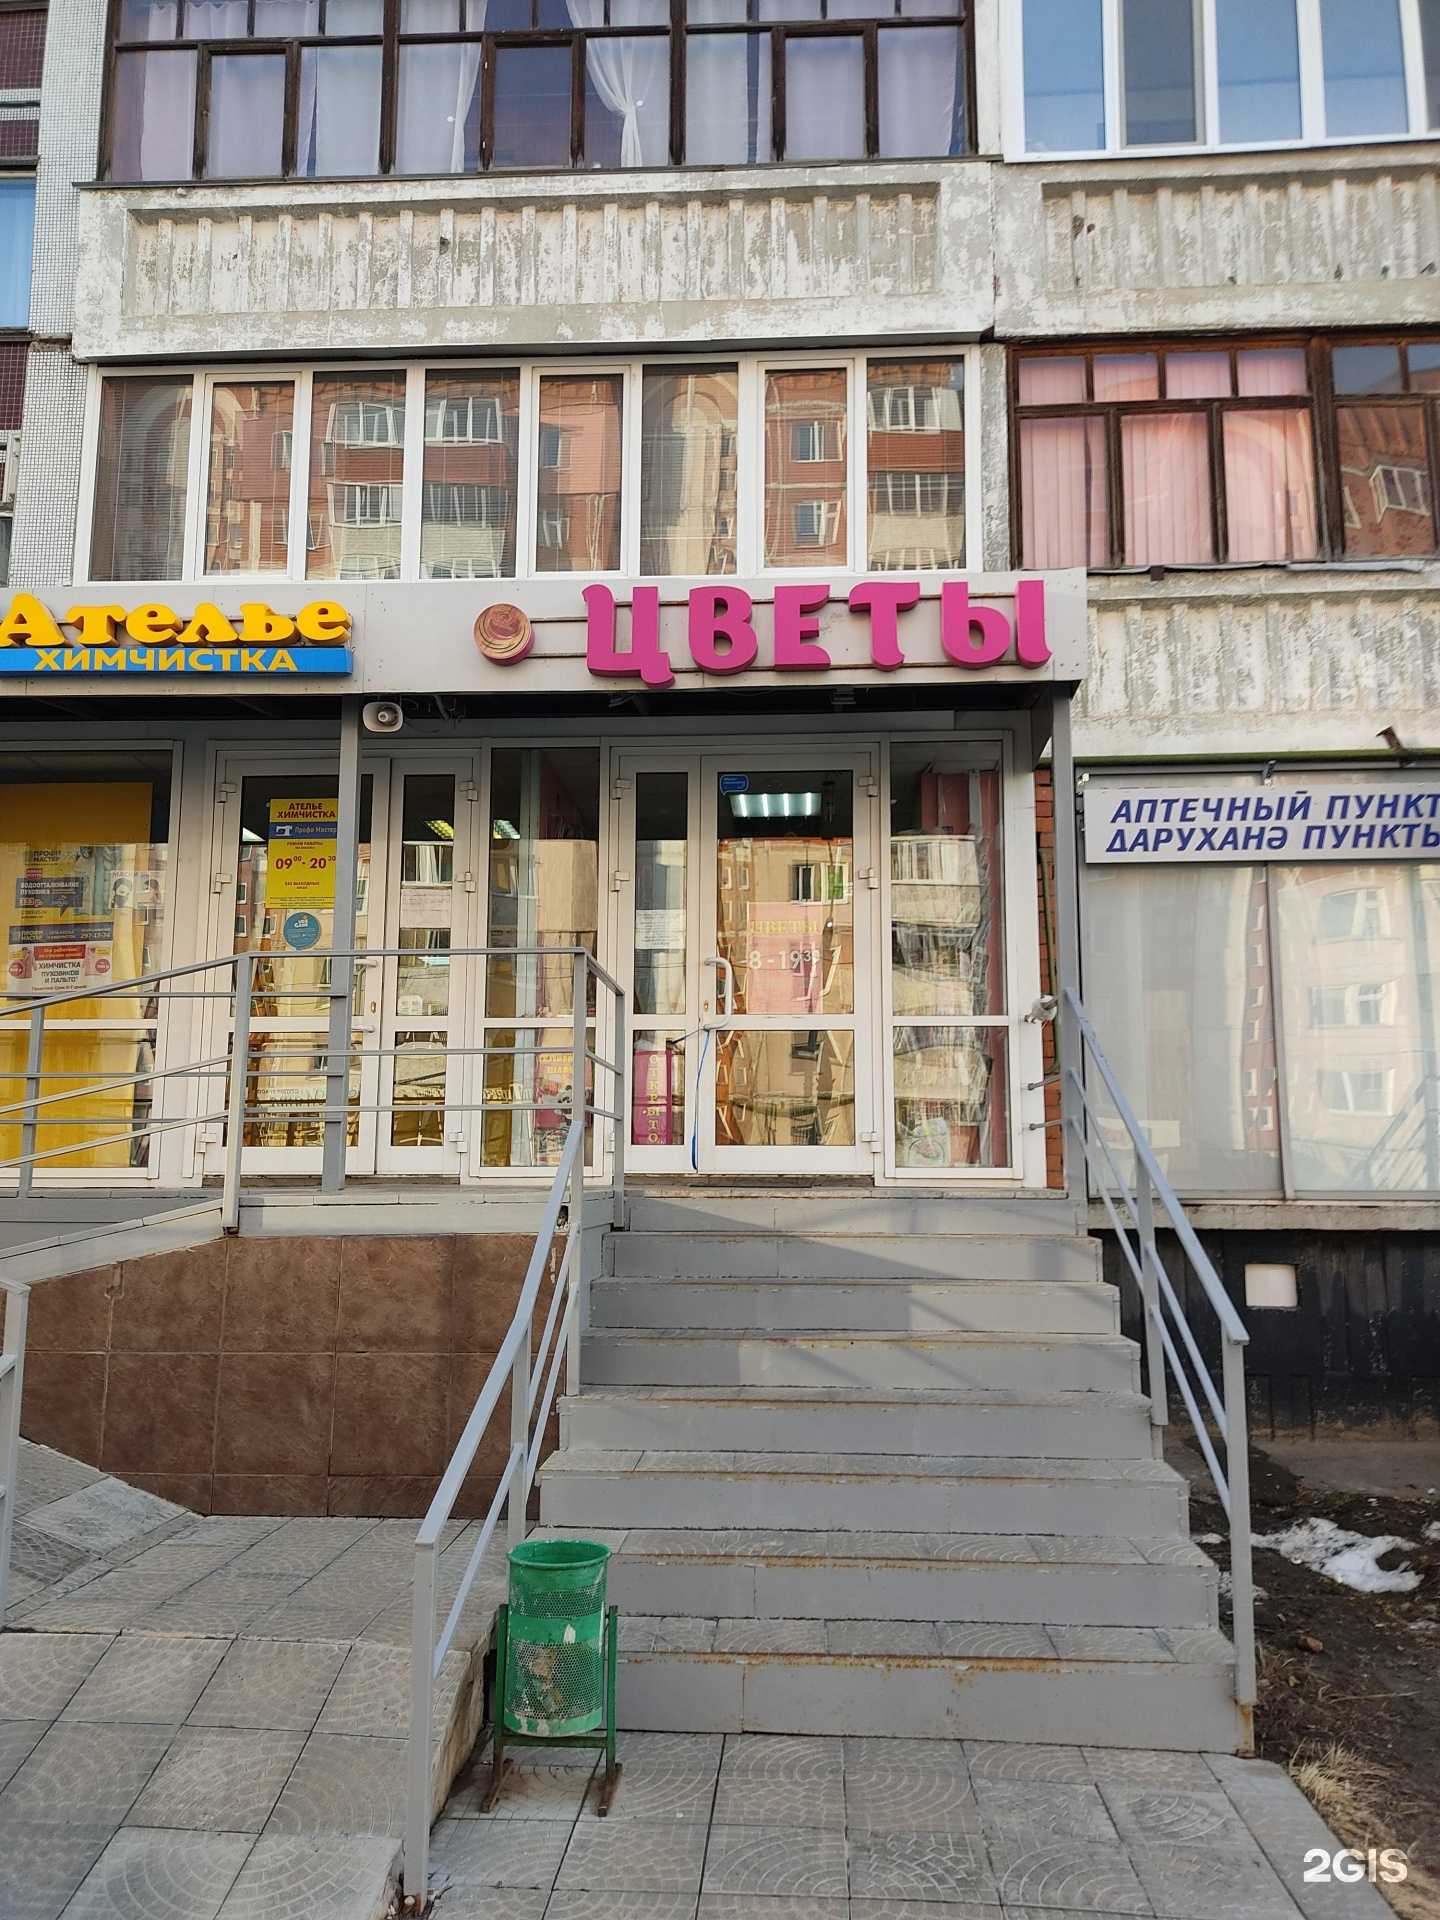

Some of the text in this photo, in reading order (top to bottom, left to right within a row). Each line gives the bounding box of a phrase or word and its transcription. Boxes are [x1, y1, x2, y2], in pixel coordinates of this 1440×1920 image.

[0, 592, 352, 647] Ателье
[582, 580, 1051, 688] ЦВЕТЫ
[33, 649, 298, 672] ХИМЧИСТКА
[277, 811, 336, 819] ХИМЧИСТКА
[288, 802, 324, 811] АТЕЛЬЕ
[1110, 791, 1440, 823] АПТЕЧНЫЙ ПУНКТ
[1105, 825, 1288, 853] ДАРУХАНӘ
[39, 961, 81, 969] ХИМЧИСТКА
